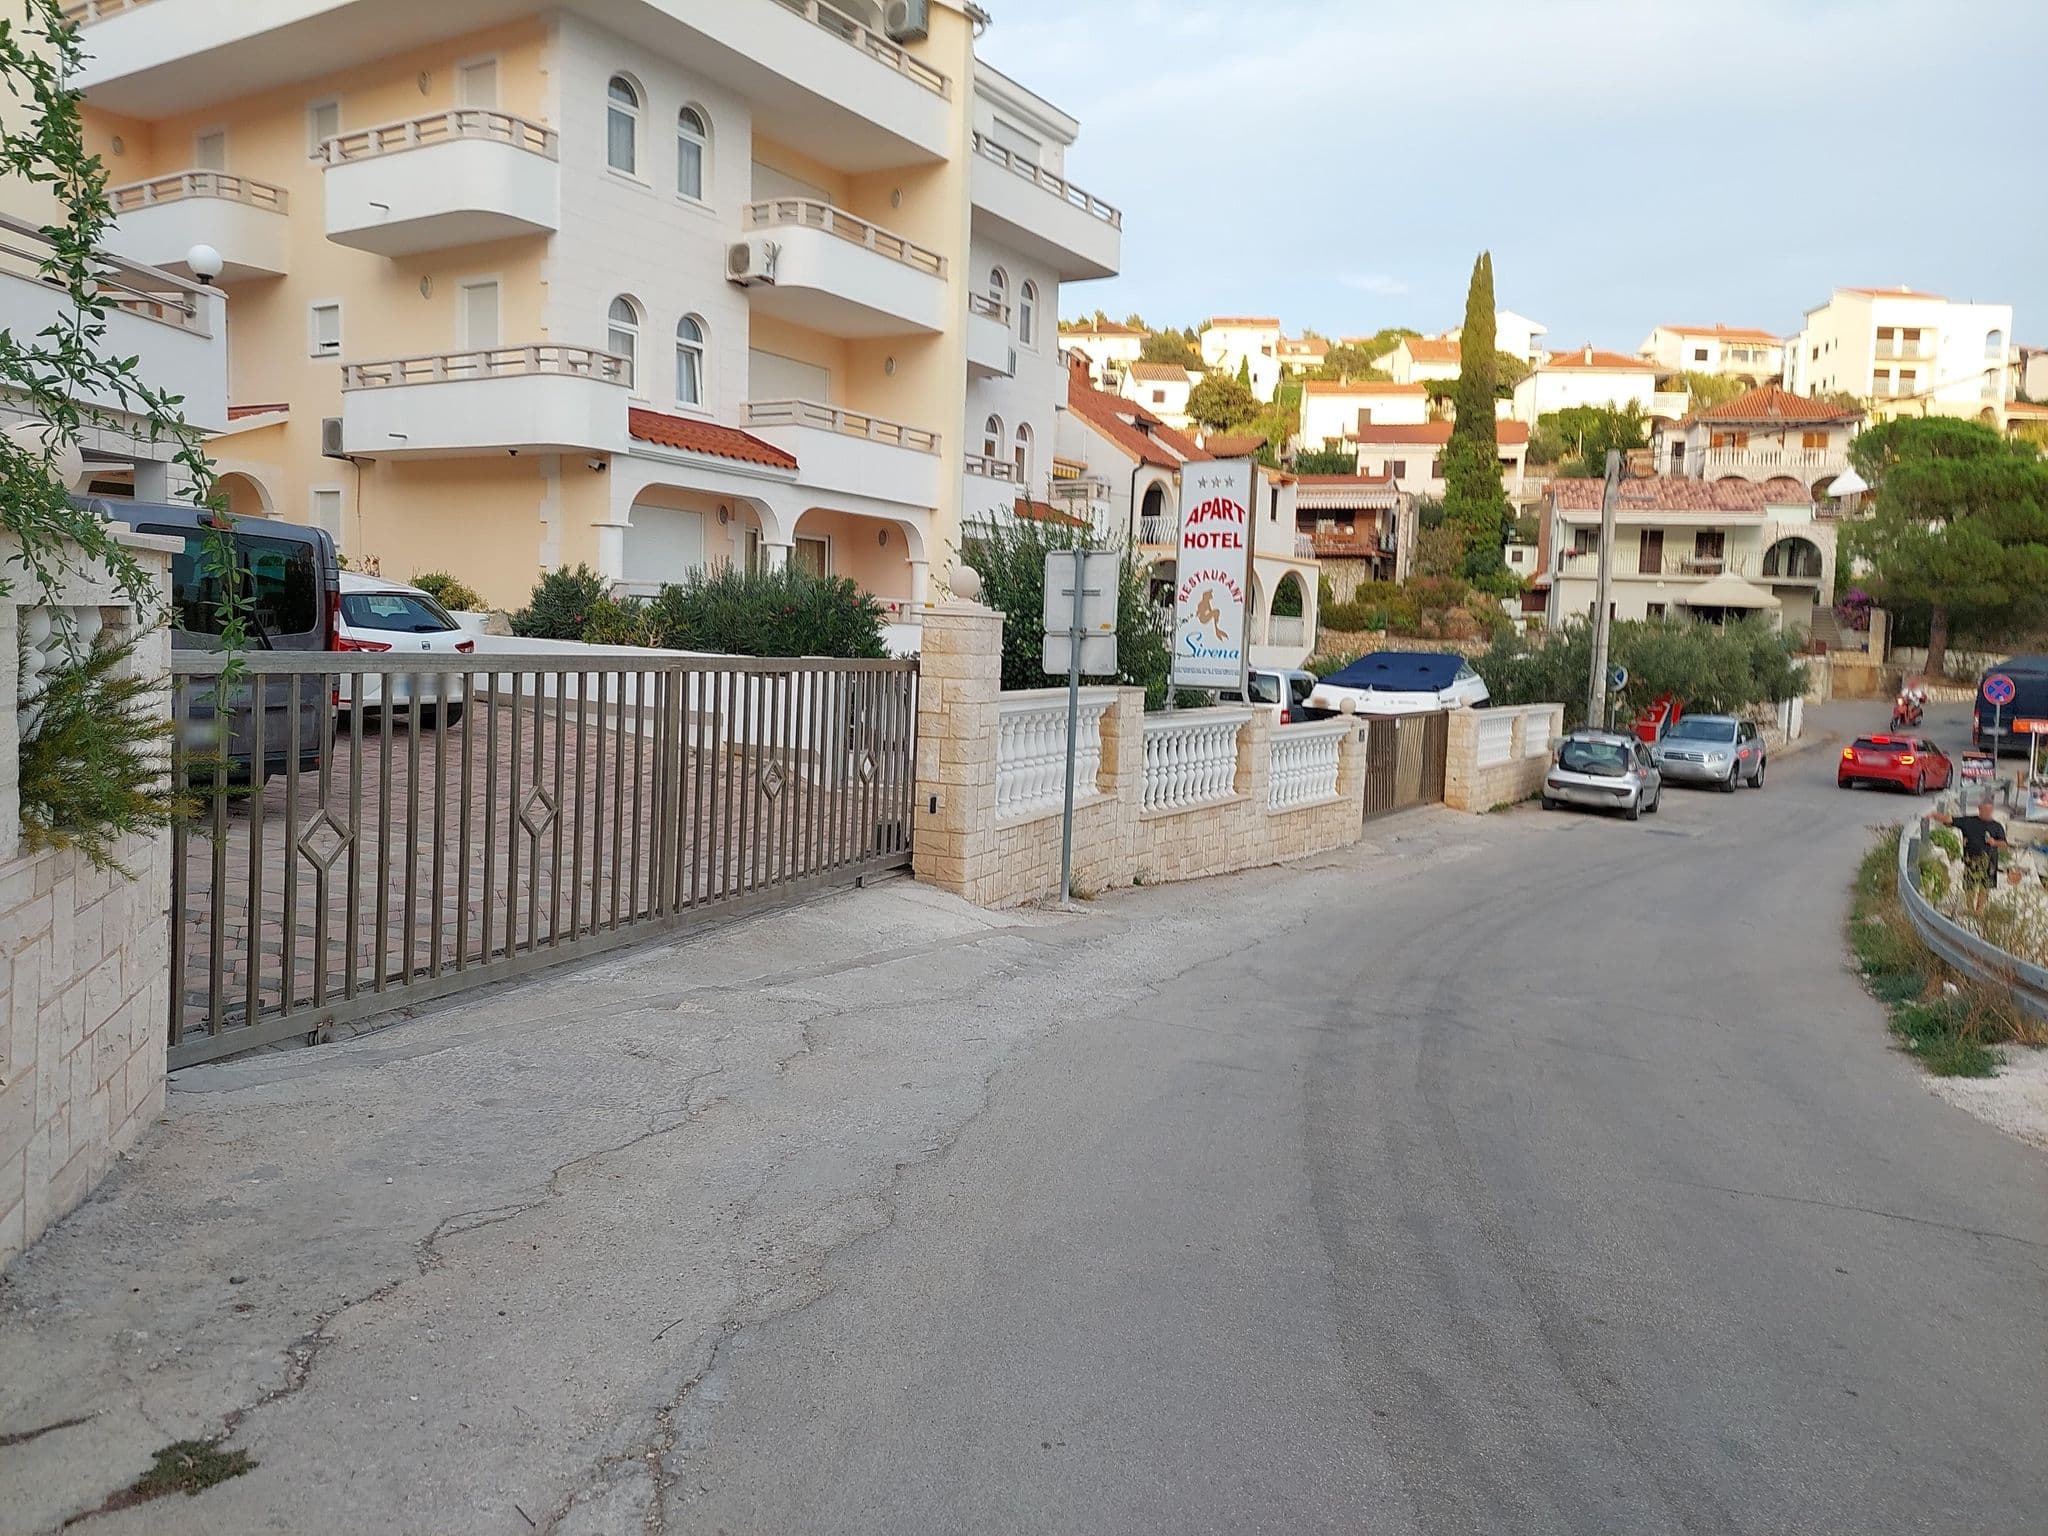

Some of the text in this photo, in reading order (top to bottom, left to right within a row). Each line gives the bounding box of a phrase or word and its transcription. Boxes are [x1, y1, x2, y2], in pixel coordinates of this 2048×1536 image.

[1186, 497, 1246, 526] APART
[1184, 533, 1243, 548] HOTEL
[1179, 569, 1243, 603] RESTAURANT
[1186, 633, 1240, 659] Sirena
